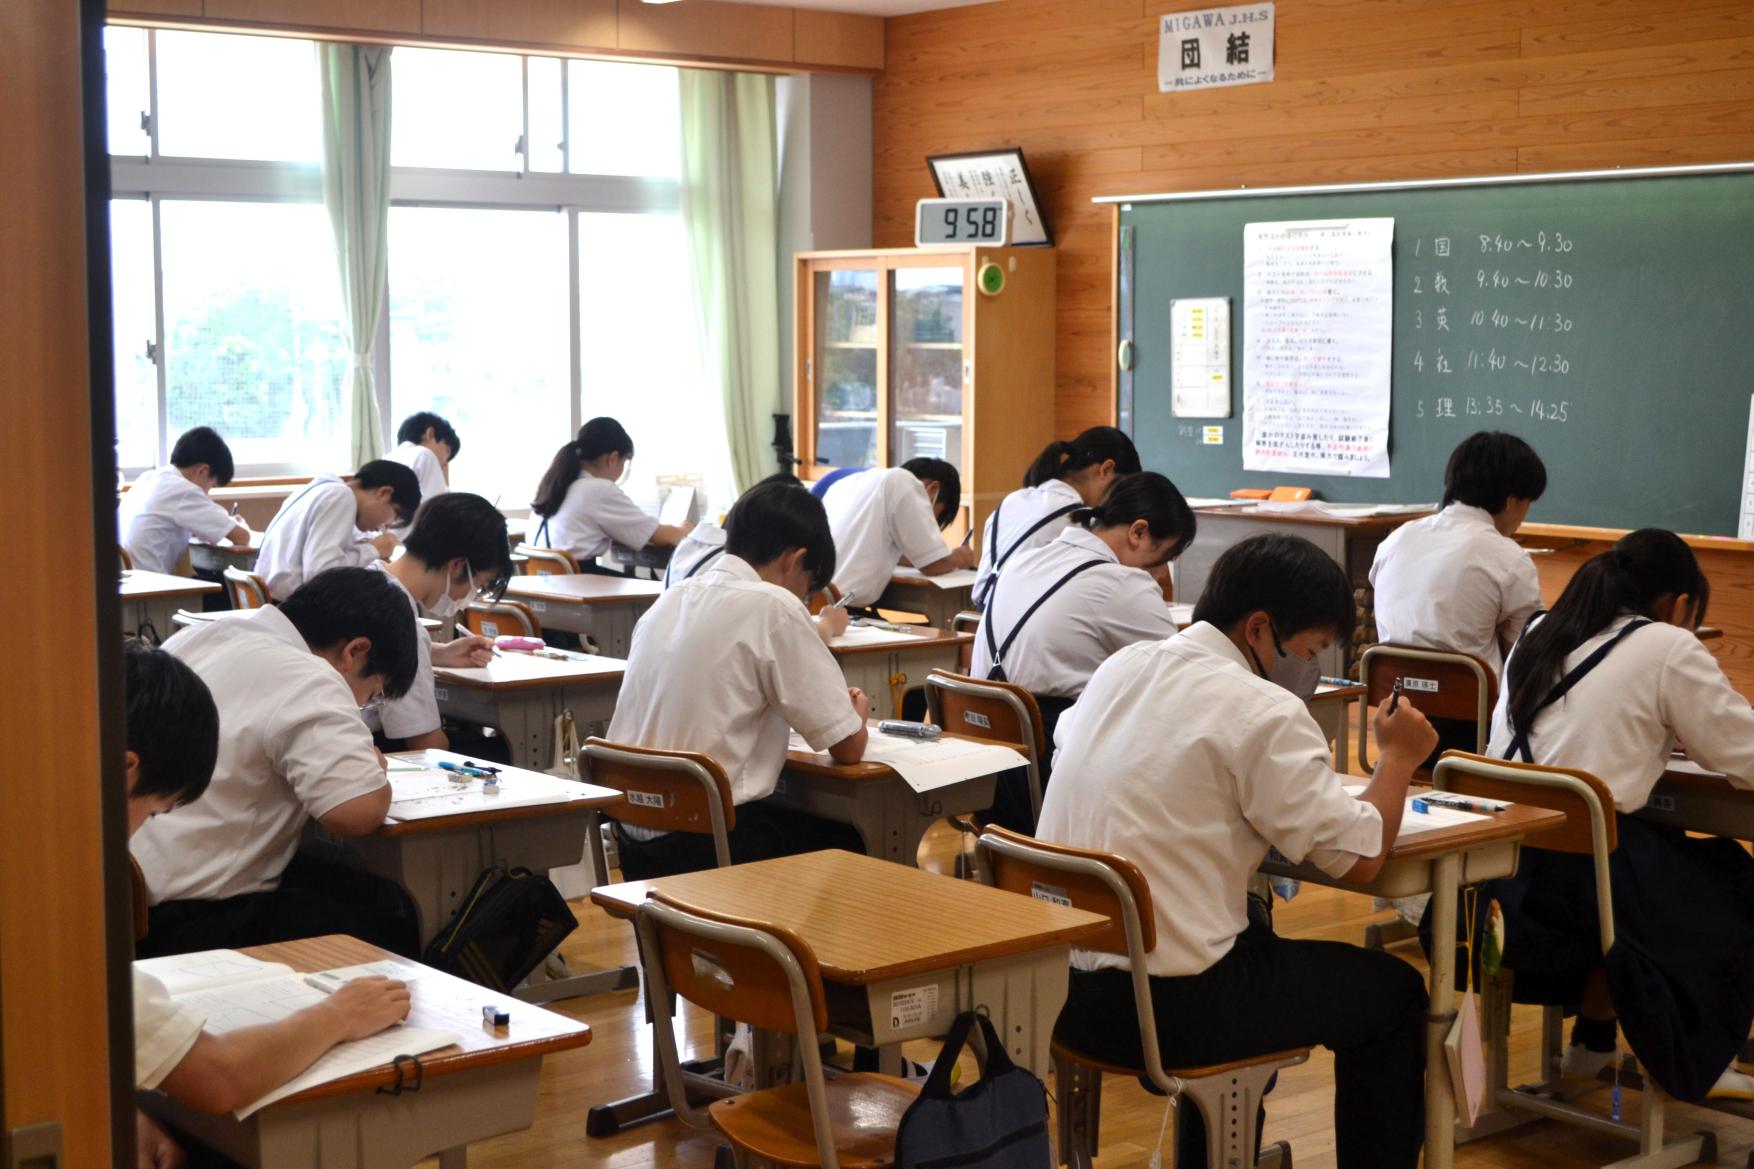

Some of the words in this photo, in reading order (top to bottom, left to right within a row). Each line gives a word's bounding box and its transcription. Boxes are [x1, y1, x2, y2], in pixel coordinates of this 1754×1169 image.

[1181, 31, 1250, 70] 団結
[1415, 238, 1421, 257] 1
[1434, 237, 1450, 256] 国
[1413, 275, 1423, 294] 2
[1434, 271, 1450, 295] 数
[1415, 310, 1423, 329] 3
[1437, 306, 1450, 331] 英
[1413, 351, 1424, 373] 4
[1436, 347, 1453, 373] 社
[1416, 400, 1425, 418] 5
[1436, 397, 1456, 418] 理
